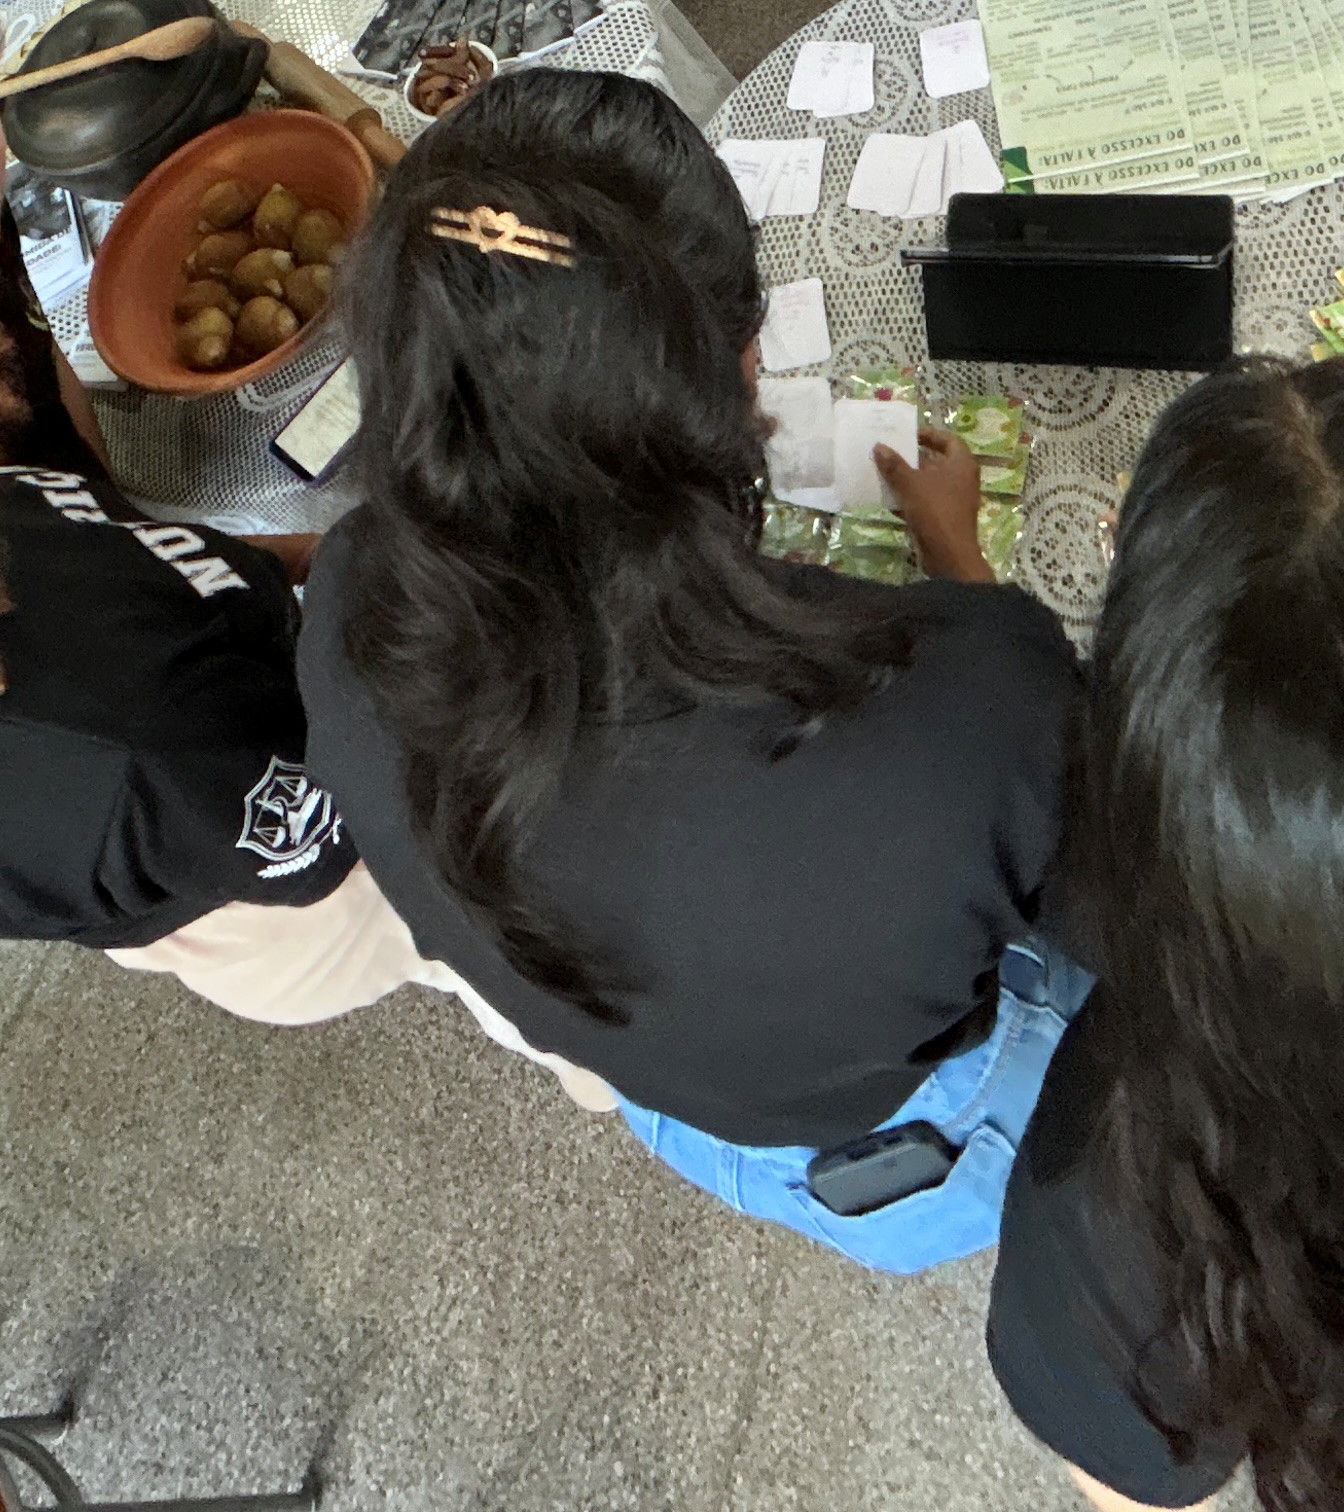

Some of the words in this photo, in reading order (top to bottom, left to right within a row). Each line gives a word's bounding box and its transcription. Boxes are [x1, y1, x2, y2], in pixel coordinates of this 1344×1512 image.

[1166, 129, 1185, 142] DO
[1221, 134, 1241, 148] DO
[1101, 134, 1161, 155] EXCESSO
[1175, 156, 1194, 169] DO
[1199, 160, 1236, 176] EXCE
[1242, 155, 1262, 169] DO
[1305, 162, 1325, 176] DO
[1108, 161, 1169, 180] EXCESSO
[1264, 169, 1299, 185] EXCE
